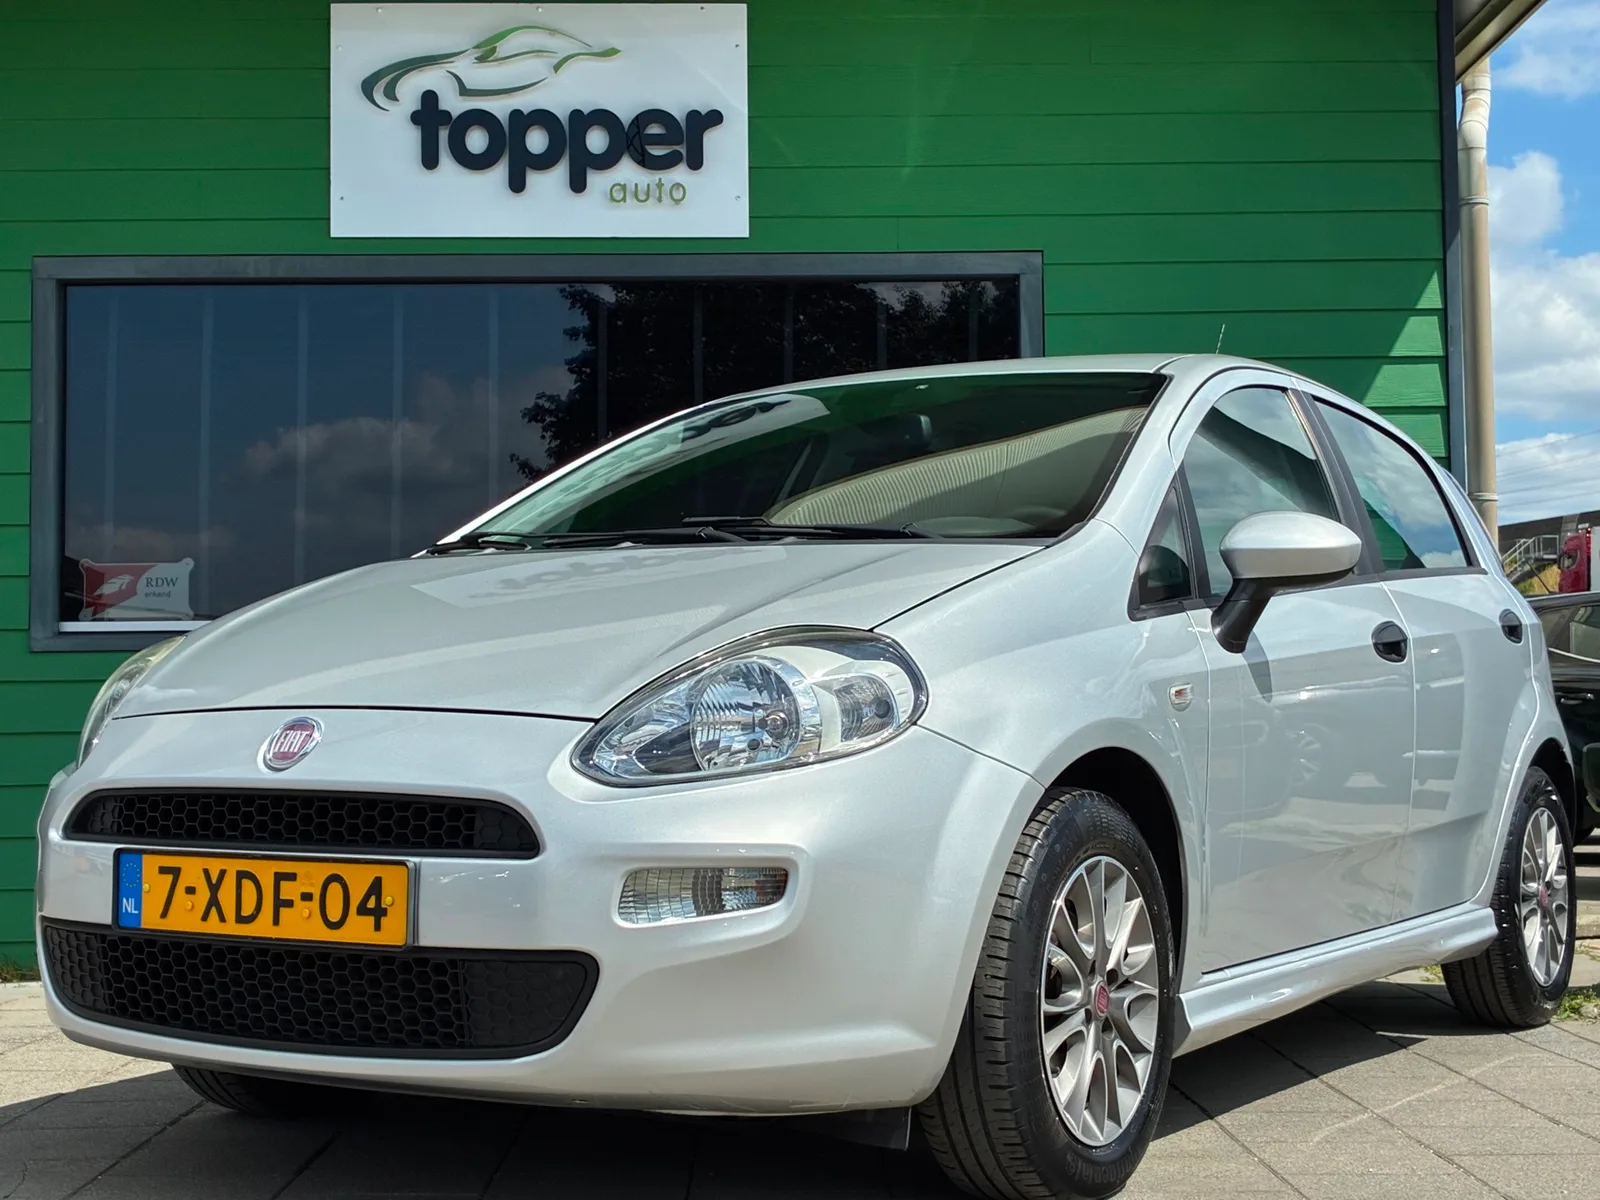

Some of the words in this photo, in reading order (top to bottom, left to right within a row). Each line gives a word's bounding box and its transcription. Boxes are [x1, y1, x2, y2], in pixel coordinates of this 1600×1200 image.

[410, 89, 724, 194] topper
[608, 178, 687, 204] auto
[145, 577, 179, 588] RDW
[144, 590, 172, 599] erkend
[273, 730, 310, 752] FIAT
[122, 897, 139, 914] NL
[157, 865, 388, 932] 7-XDF-04
